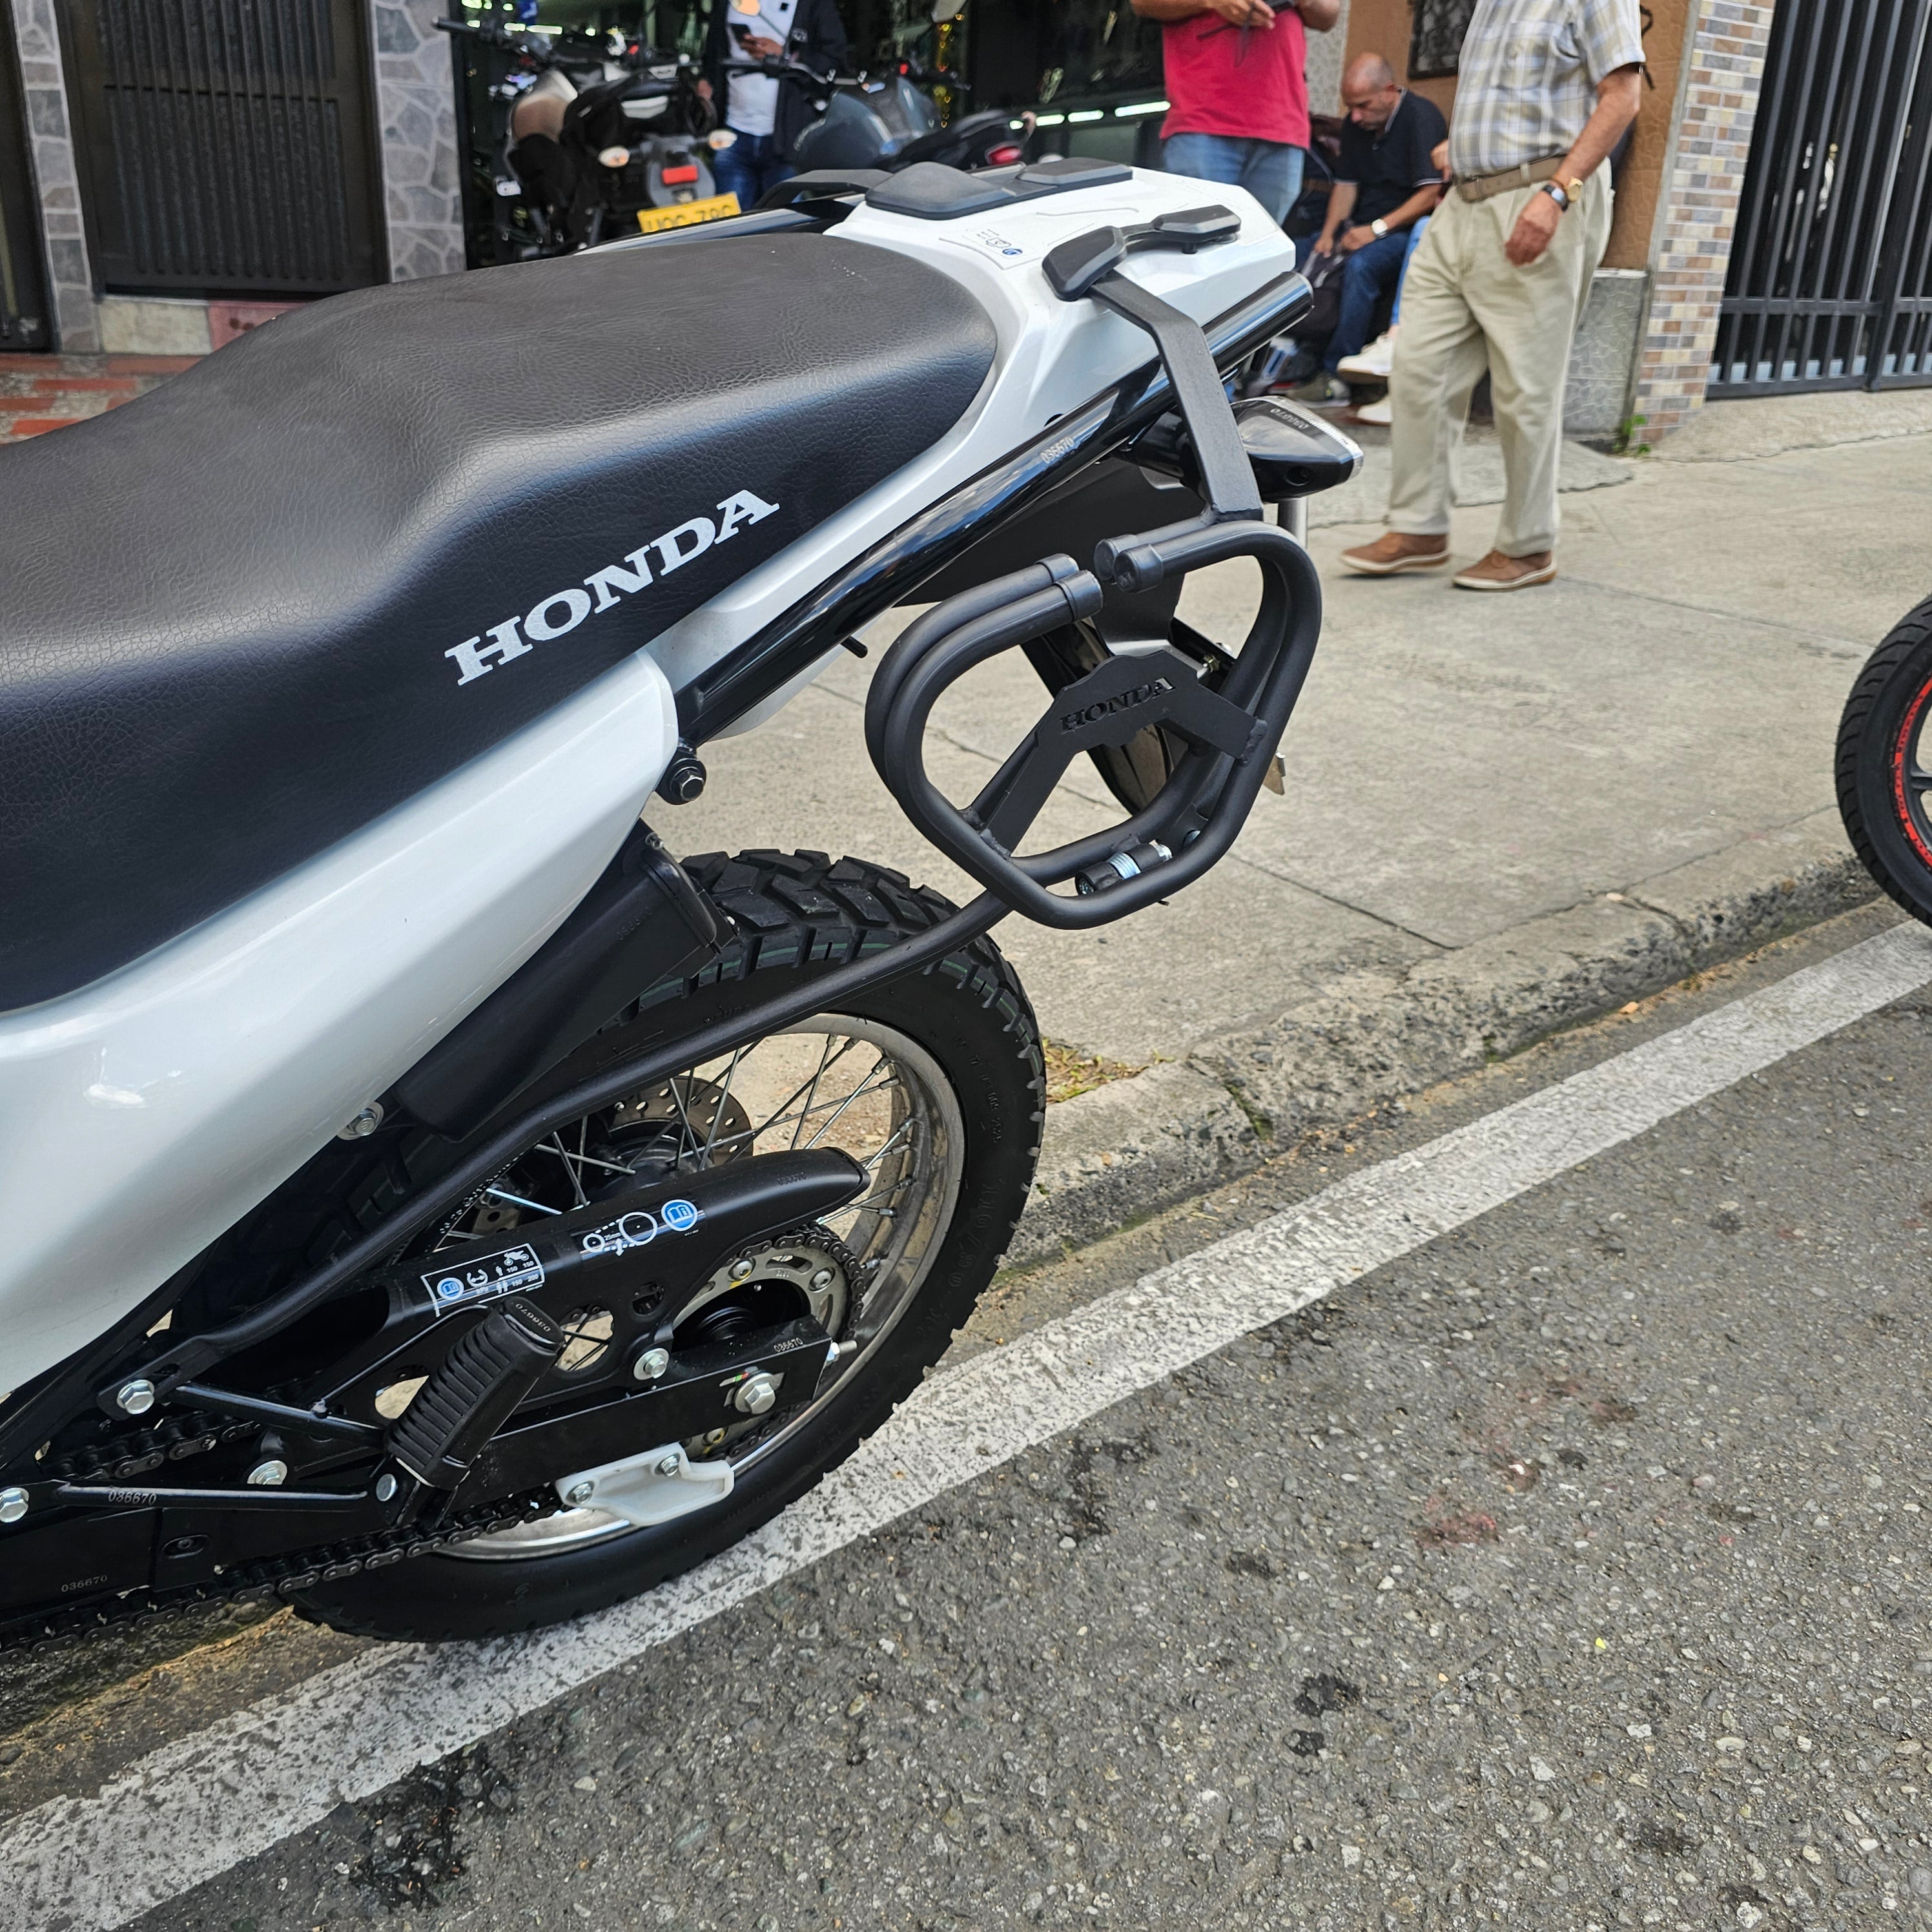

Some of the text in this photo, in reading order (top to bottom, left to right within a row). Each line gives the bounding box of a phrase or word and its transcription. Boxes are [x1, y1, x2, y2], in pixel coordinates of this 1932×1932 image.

[444, 489, 780, 686] HONDA
[1060, 677, 1176, 734] HONDA
[515, 1303, 551, 1331] 036670
[774, 1337, 804, 1353] 036670
[108, 1488, 157, 1506] 036670
[61, 1575, 108, 1592] 036670
